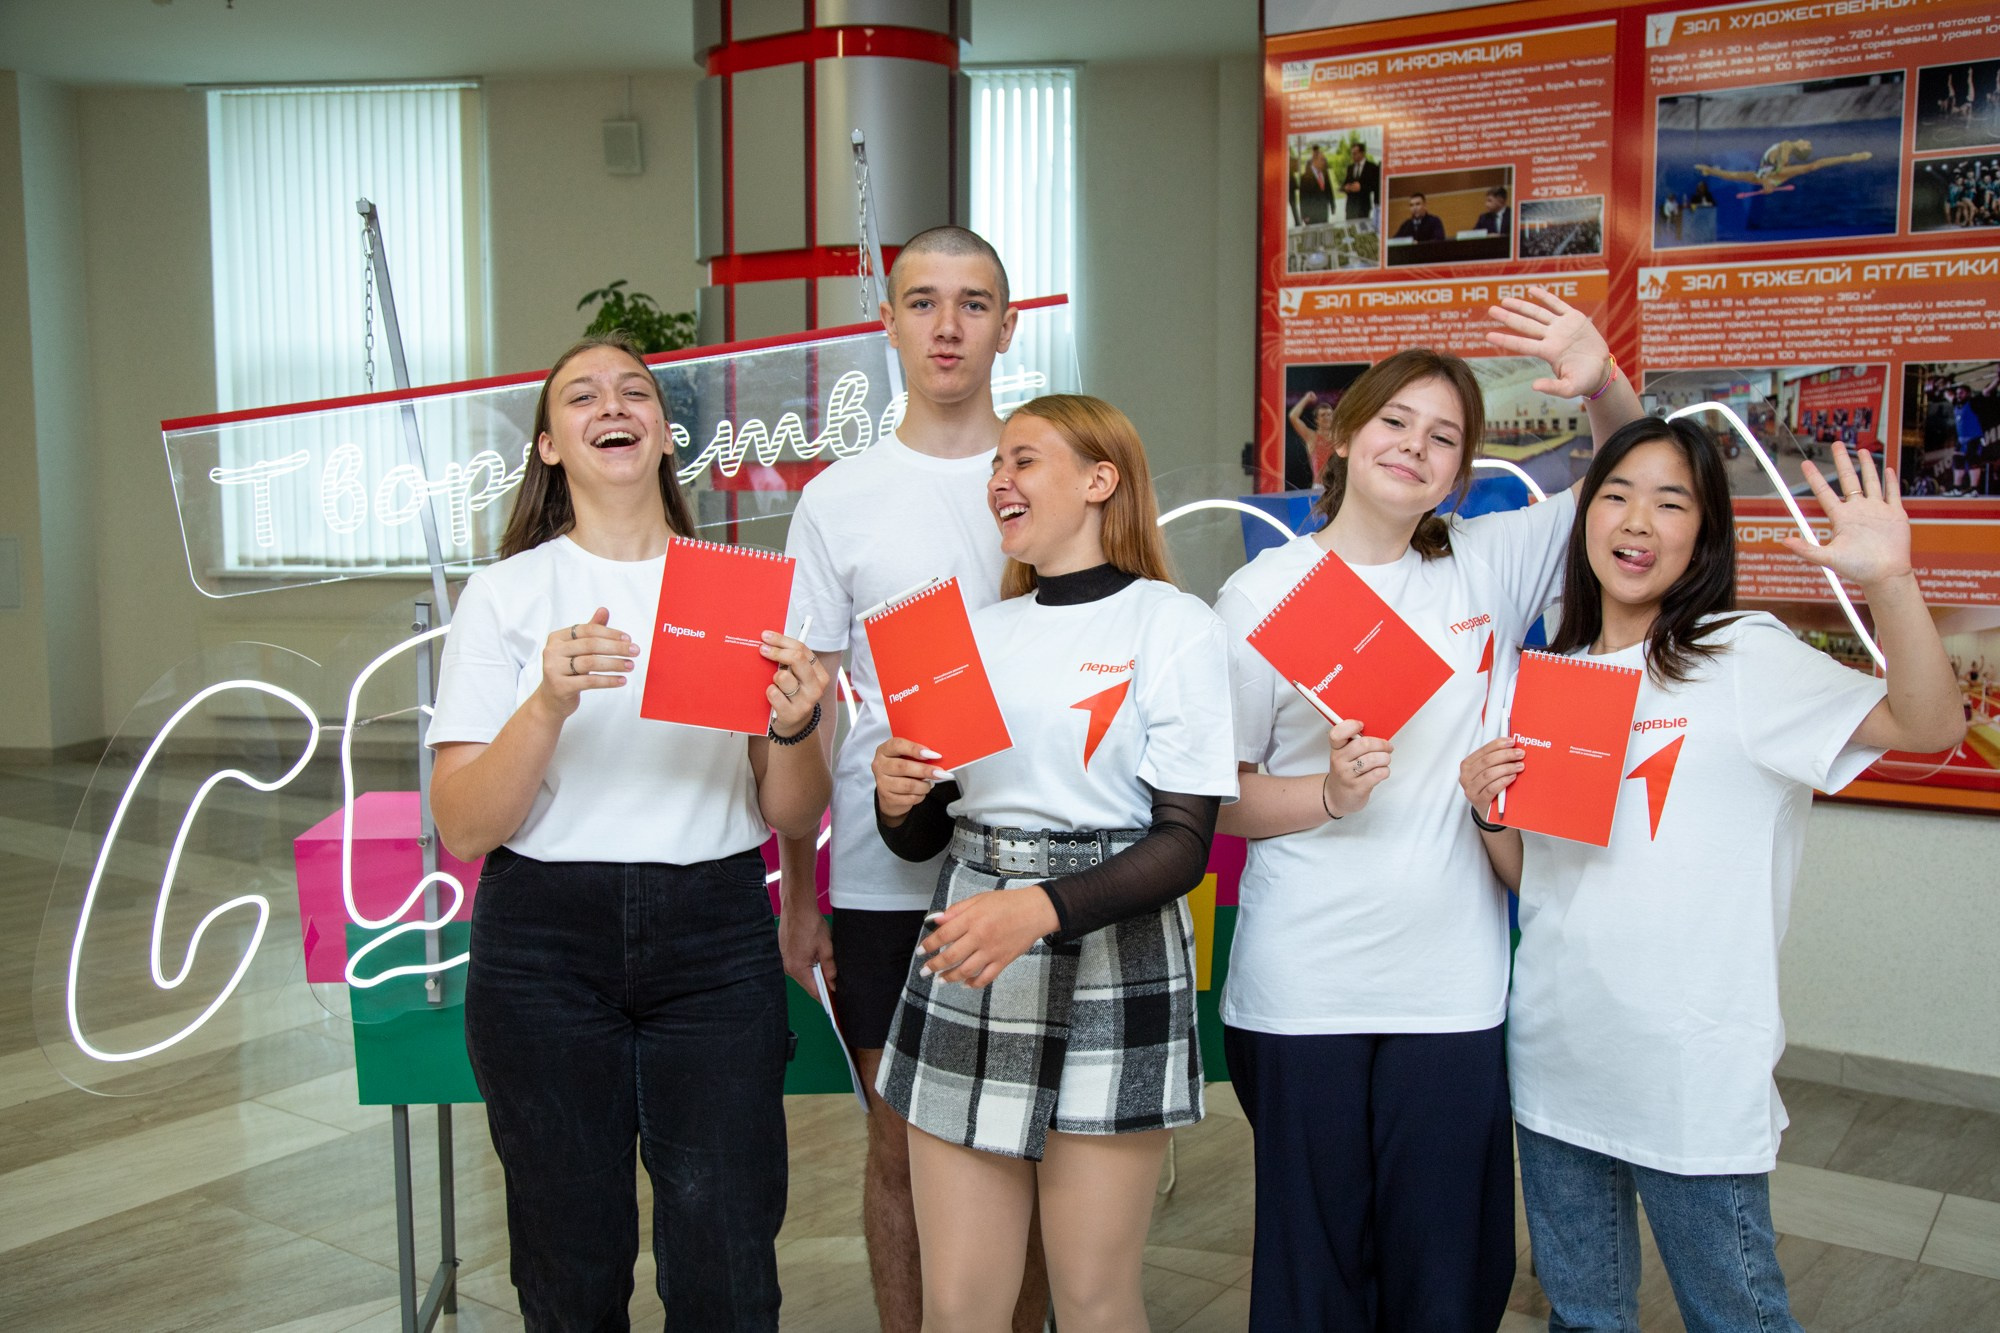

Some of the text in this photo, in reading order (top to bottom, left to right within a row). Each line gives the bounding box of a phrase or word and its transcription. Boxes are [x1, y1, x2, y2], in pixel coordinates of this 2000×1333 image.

[1682, 18, 1720, 36] ЗАЛ
[1937, 16, 1990, 29] потолков
[1861, 33, 1937, 51] соревнования
[1942, 27, 1981, 42] уровня
[1314, 42, 1523, 82] ОБЩАЯ ИНФОРМАЦИЯ
[1774, 60, 1792, 72] 100
[1681, 258, 1999, 292] ЗАЛ ТЯЖЕЛОЙ АТЛЕТИКИ
[1314, 294, 1351, 309] ЗАЛ
[1358, 288, 1453, 308] ПРЫЖКОВ
[1462, 286, 1489, 302] НА
[663, 623, 705, 639] Первые
[1311, 663, 1343, 697] Первые
[889, 683, 919, 704] Первые
[1632, 717, 1687, 734] ервые
[1513, 732, 1552, 749] Первые
